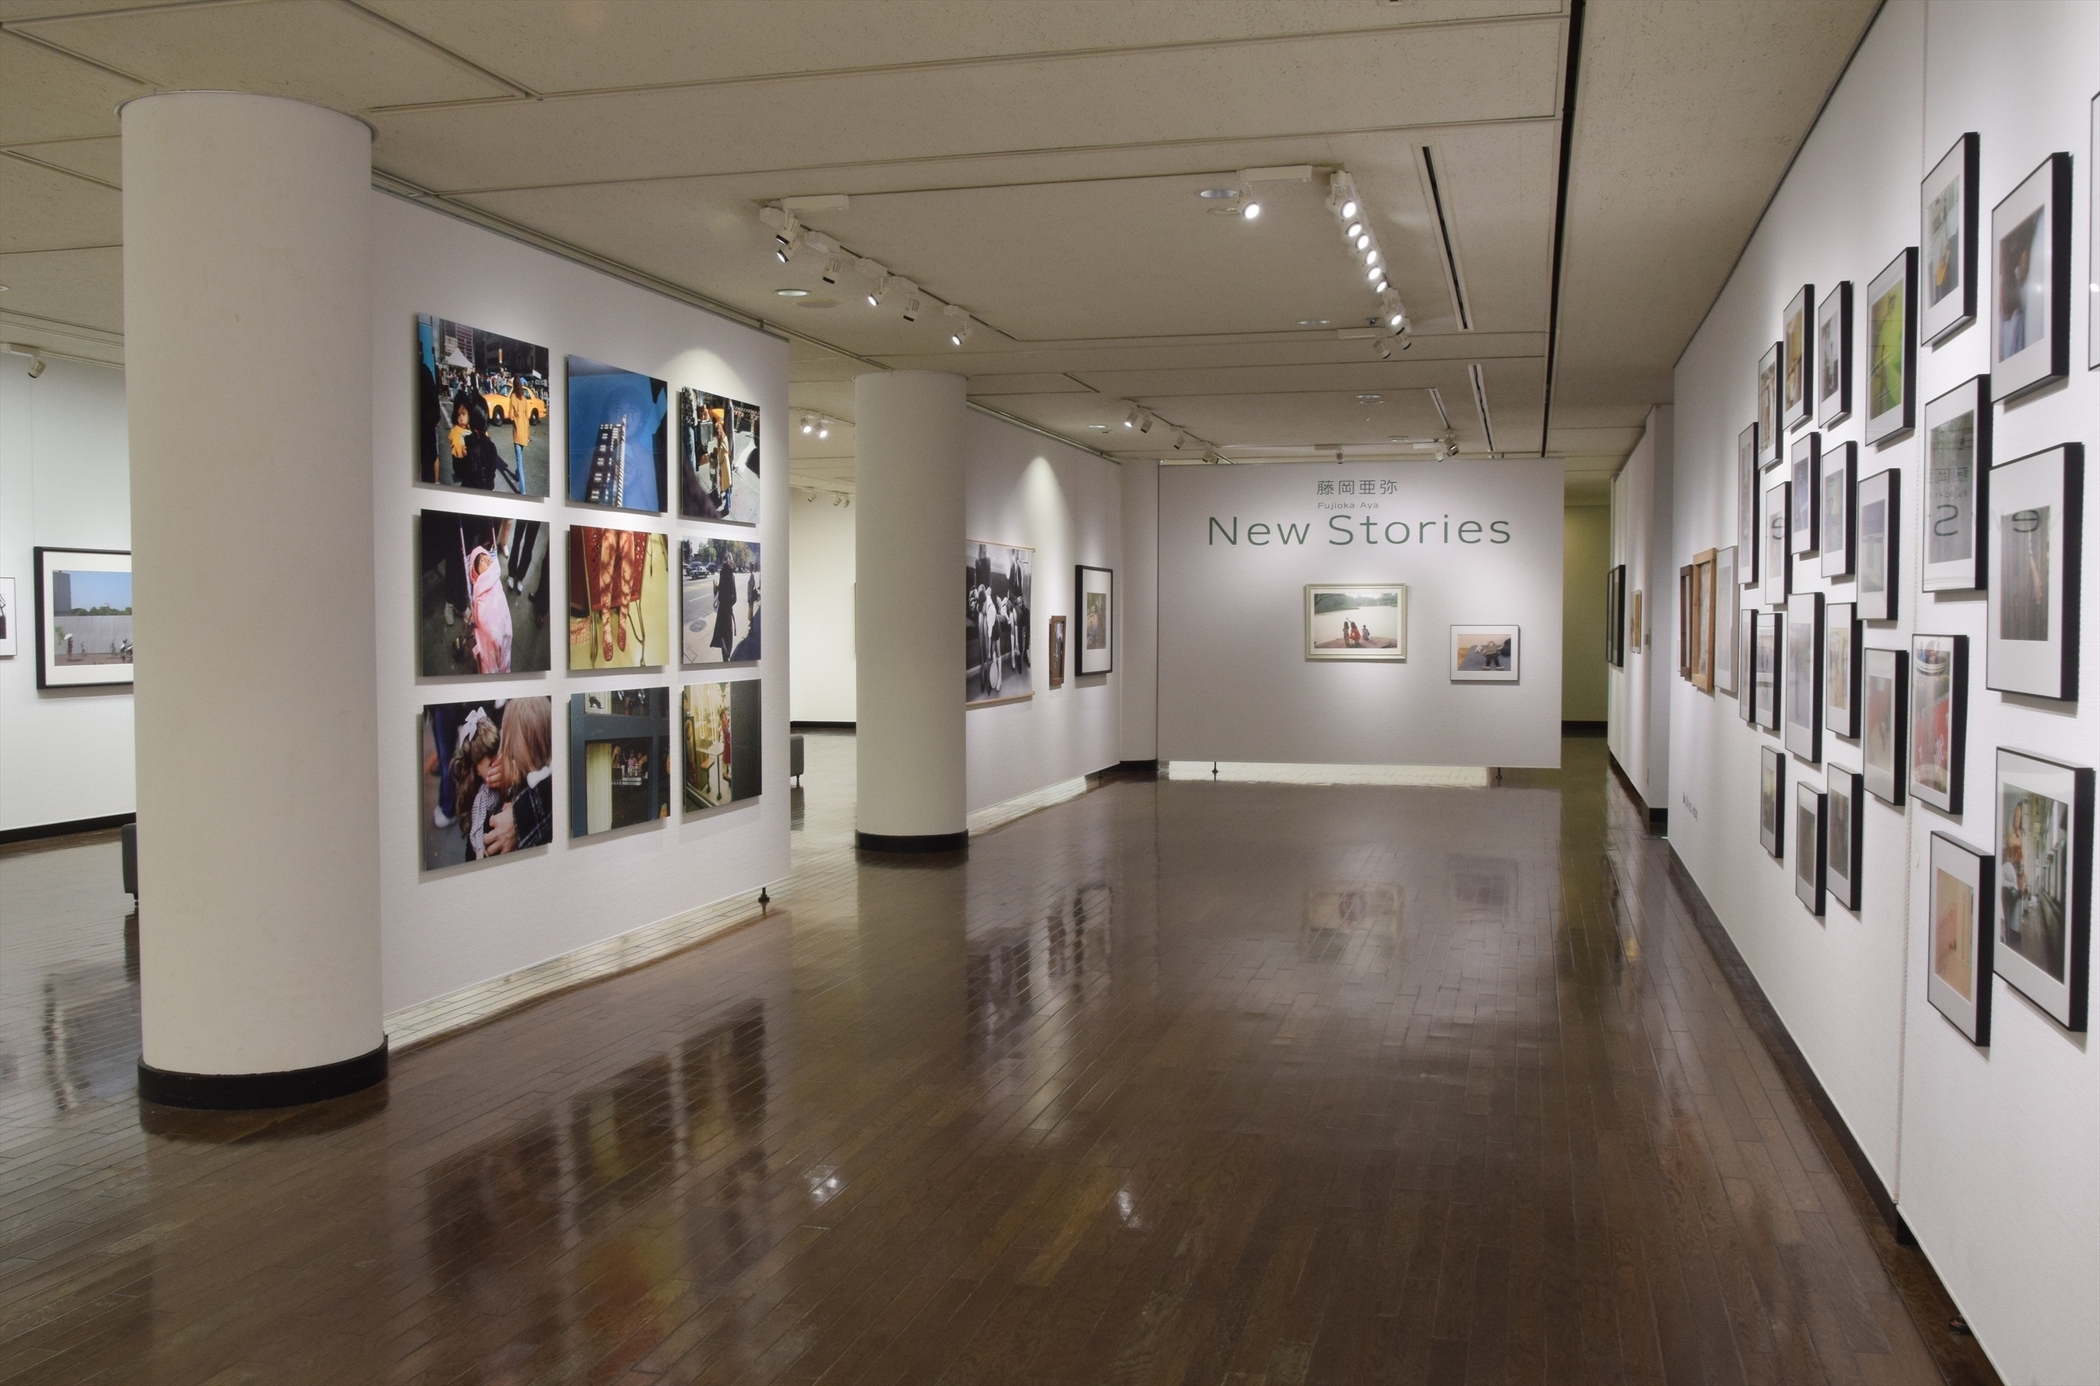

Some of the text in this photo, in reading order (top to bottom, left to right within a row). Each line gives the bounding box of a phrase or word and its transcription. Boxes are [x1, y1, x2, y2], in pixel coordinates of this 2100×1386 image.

[1316, 479, 1398, 496] 藤岡亜弥
[1317, 501, 1379, 511] Fujioka Aya
[1208, 514, 1511, 546] New Stories
